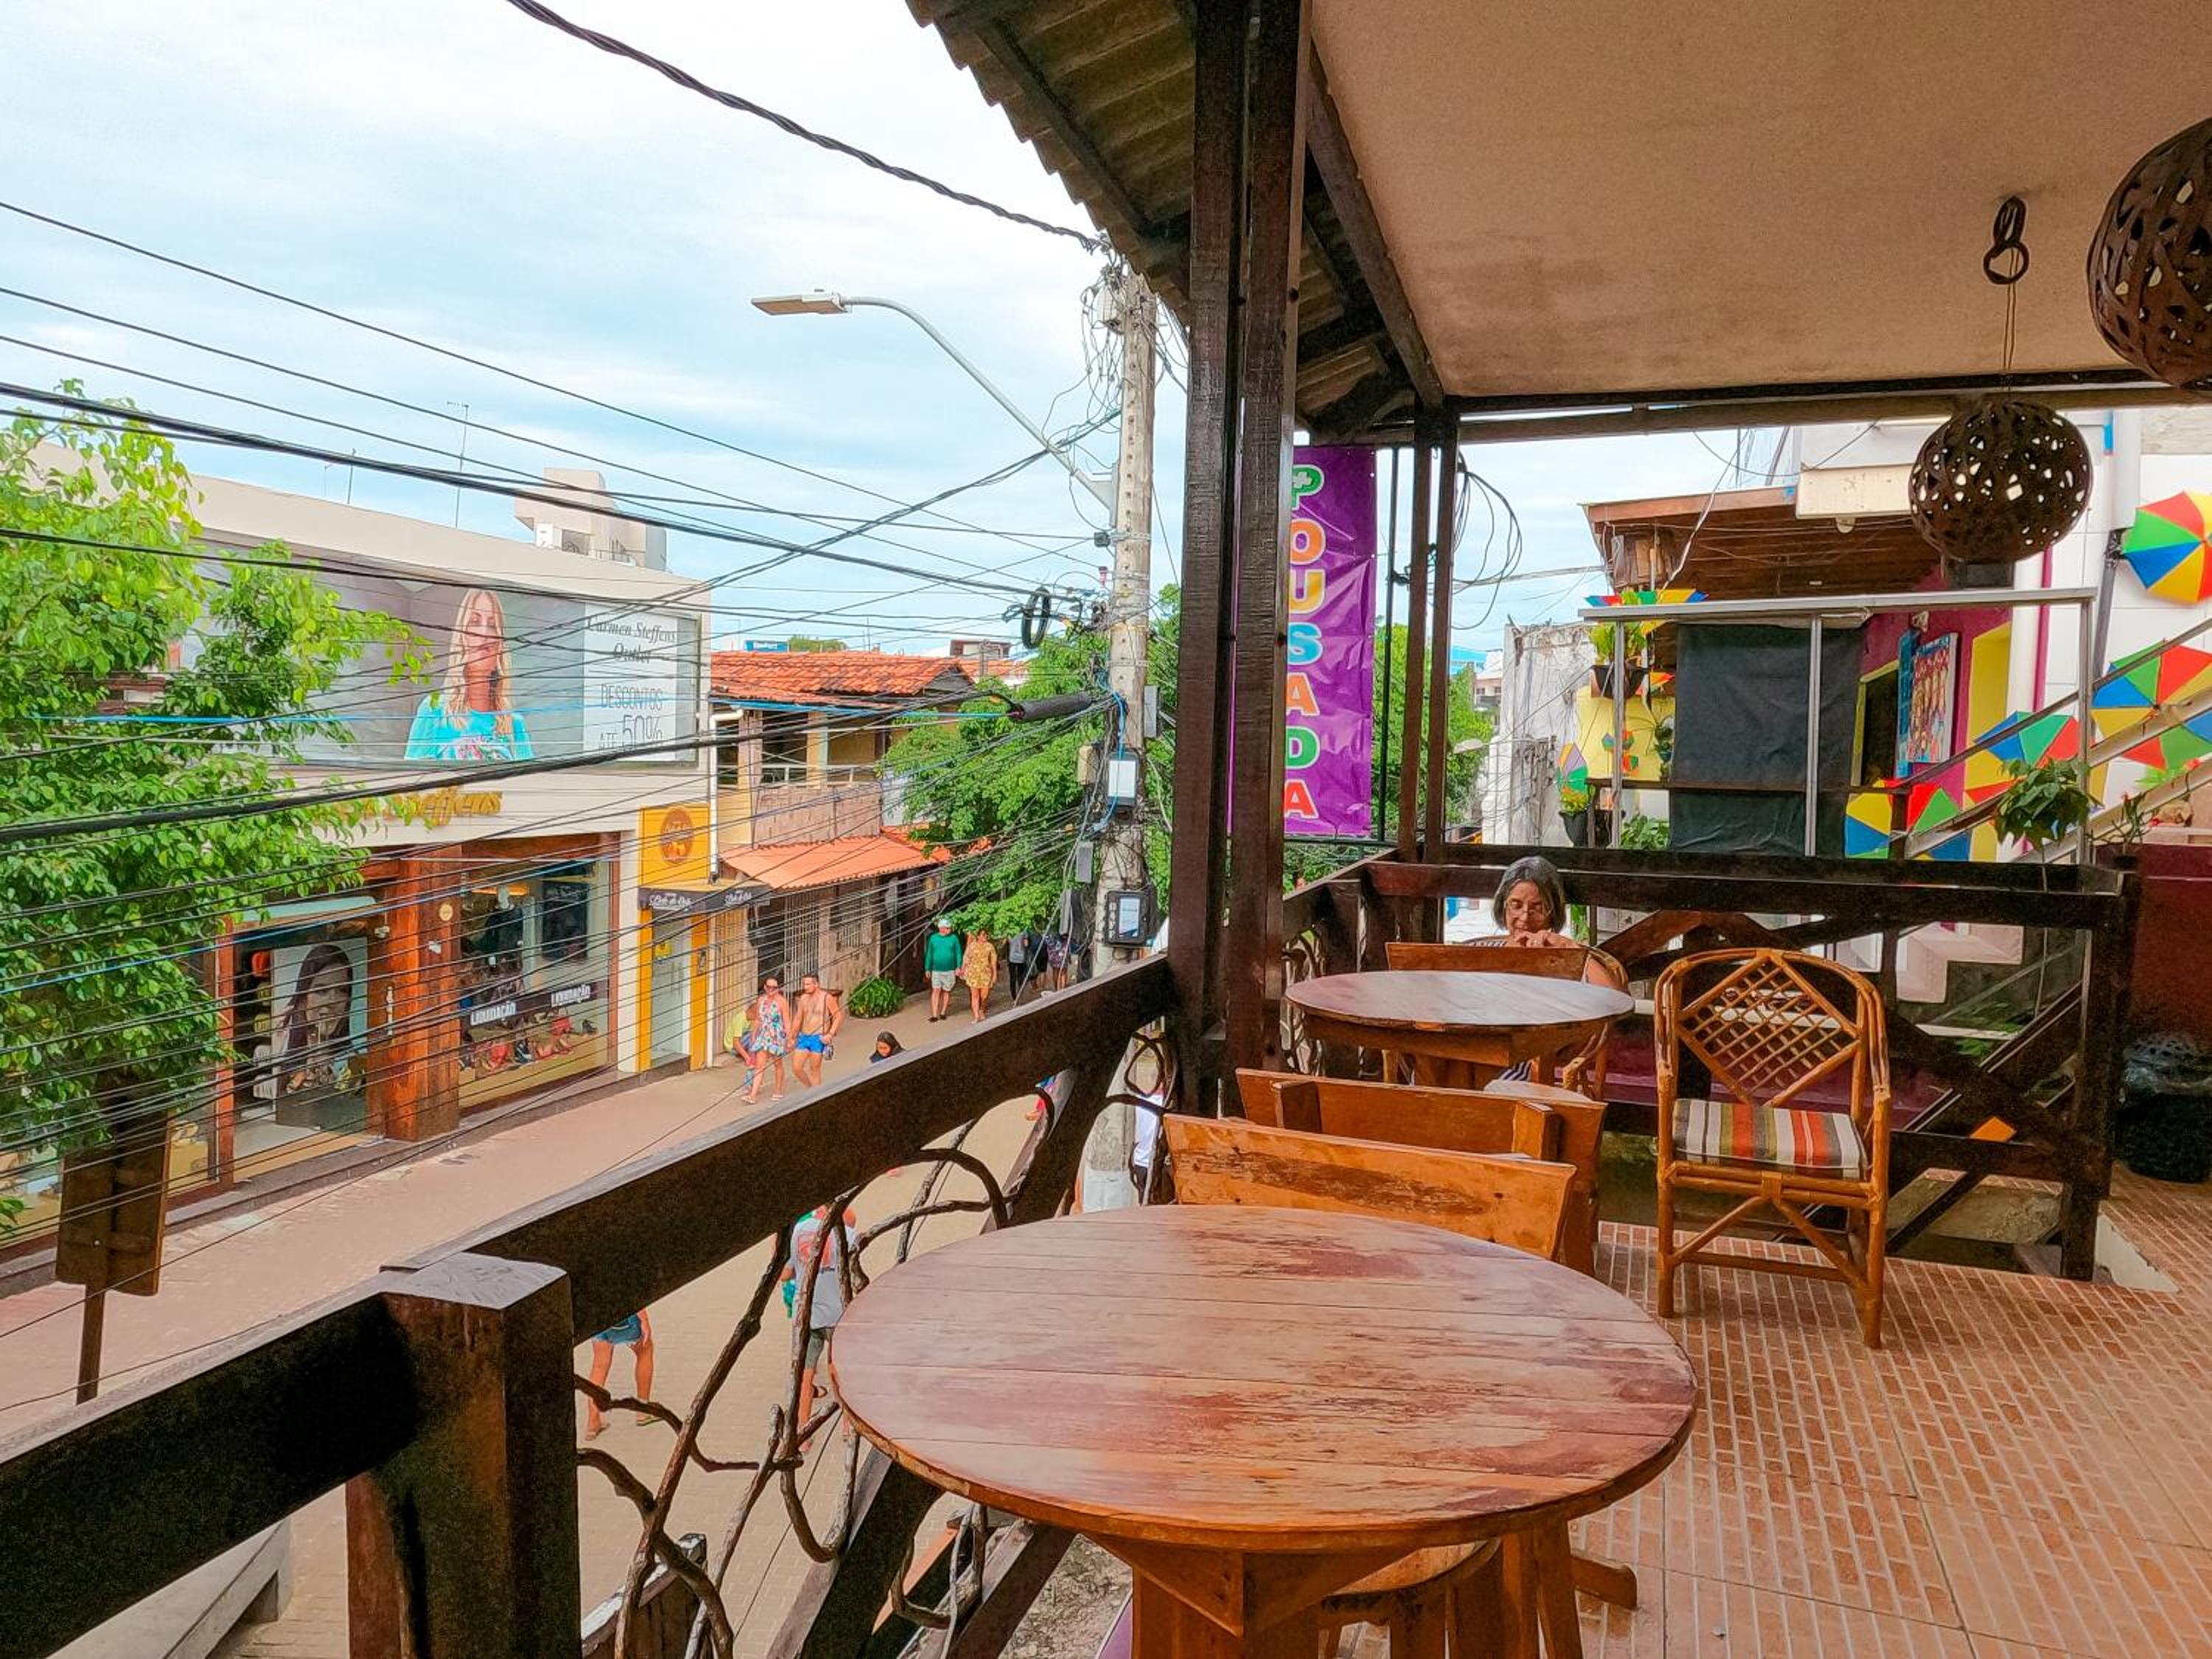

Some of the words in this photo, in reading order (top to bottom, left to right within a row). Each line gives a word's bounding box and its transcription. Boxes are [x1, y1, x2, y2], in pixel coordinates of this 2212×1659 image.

[636, 622, 676, 644] Steffens
[1284, 464, 1326, 818] POUSADA
[601, 684, 663, 711] DESCONTOS
[622, 714, 663, 751] 50%
